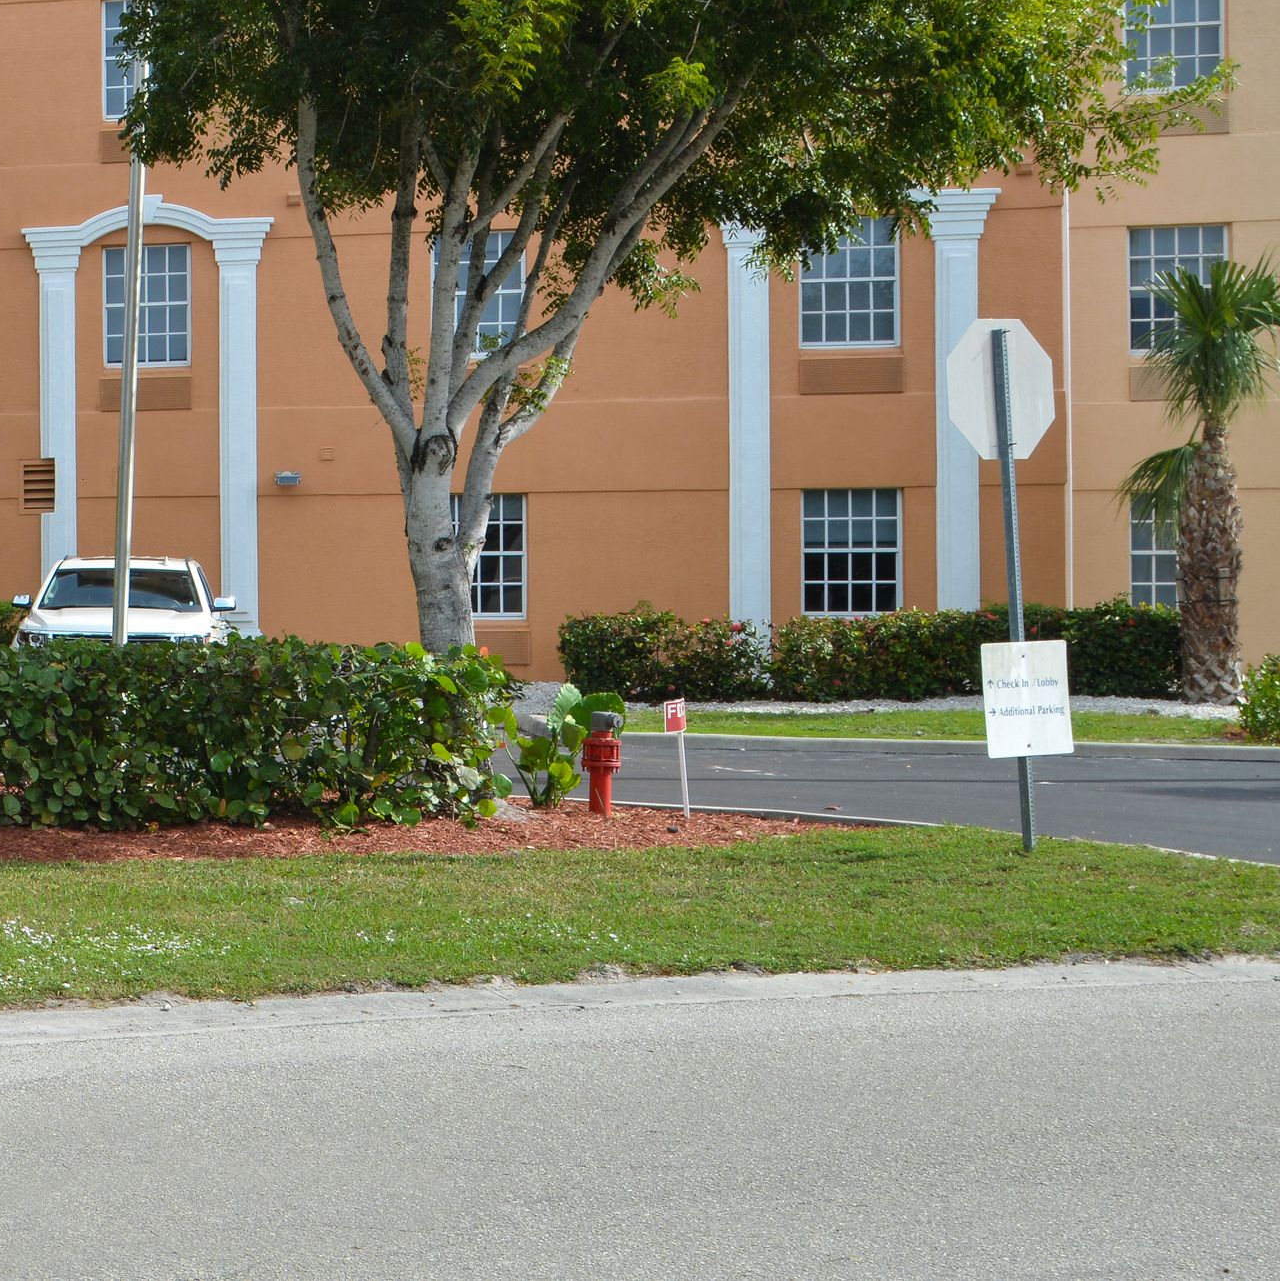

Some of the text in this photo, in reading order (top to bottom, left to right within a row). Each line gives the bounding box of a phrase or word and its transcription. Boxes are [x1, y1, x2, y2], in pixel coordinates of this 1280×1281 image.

[996, 678, 1020, 689] Check
[1021, 678, 1029, 688] In
[999, 704, 1065, 717] Additional Parking
